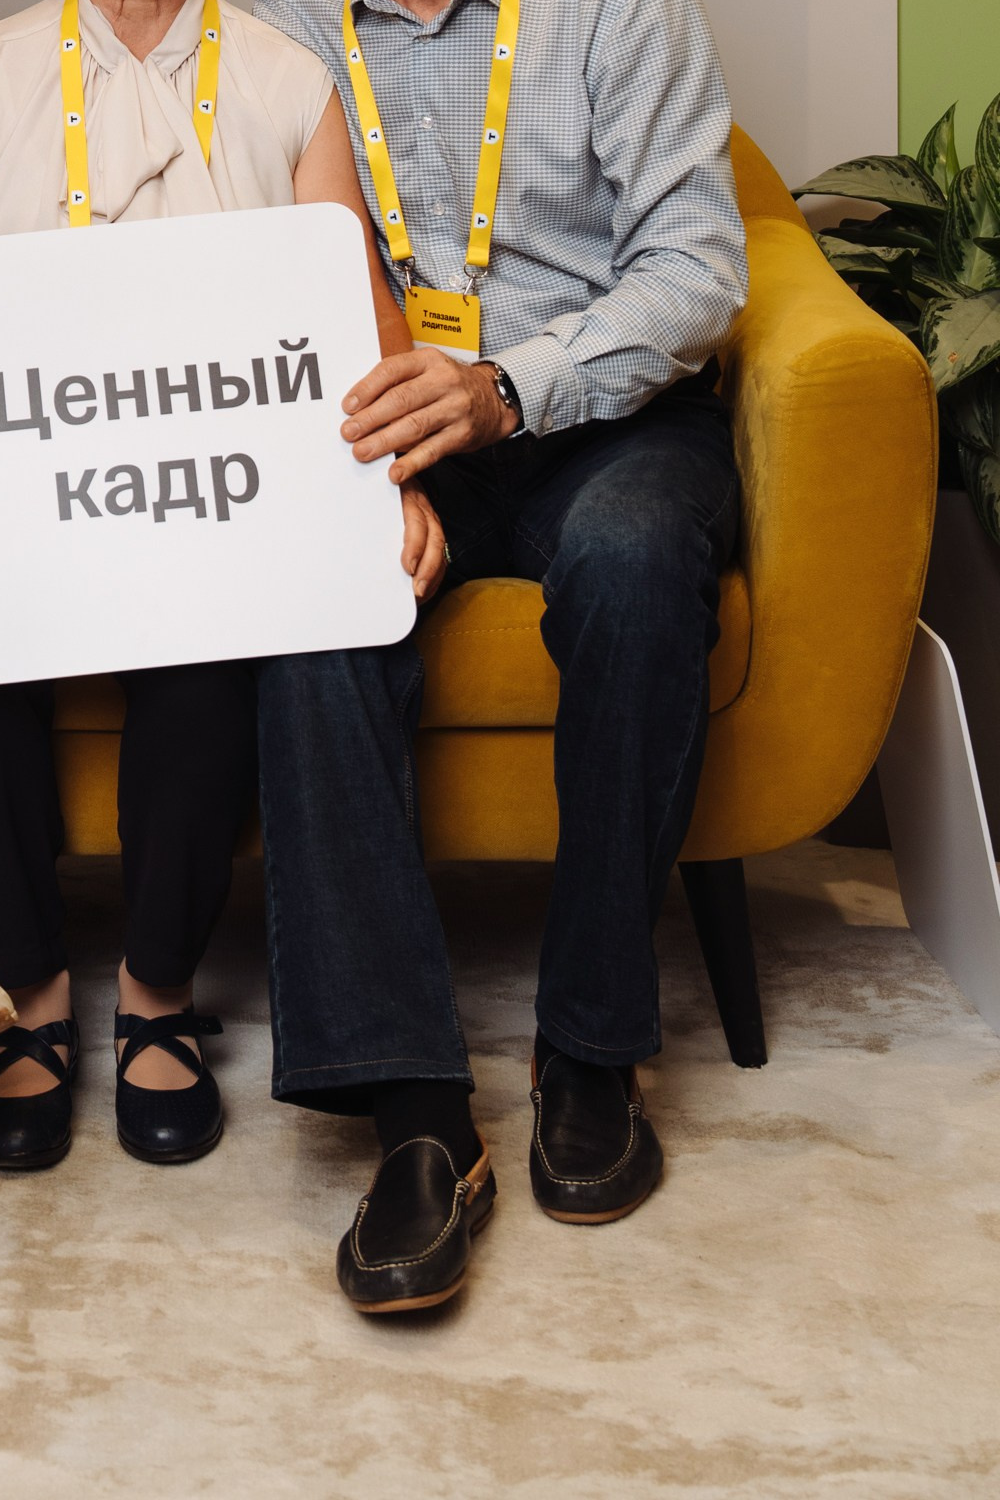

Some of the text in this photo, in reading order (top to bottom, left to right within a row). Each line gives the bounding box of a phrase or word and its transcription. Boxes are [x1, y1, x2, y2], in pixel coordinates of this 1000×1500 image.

[423, 309, 460, 323] Т глазами
[421, 320, 462, 333] родителей
[55, 451, 260, 523] кадр
